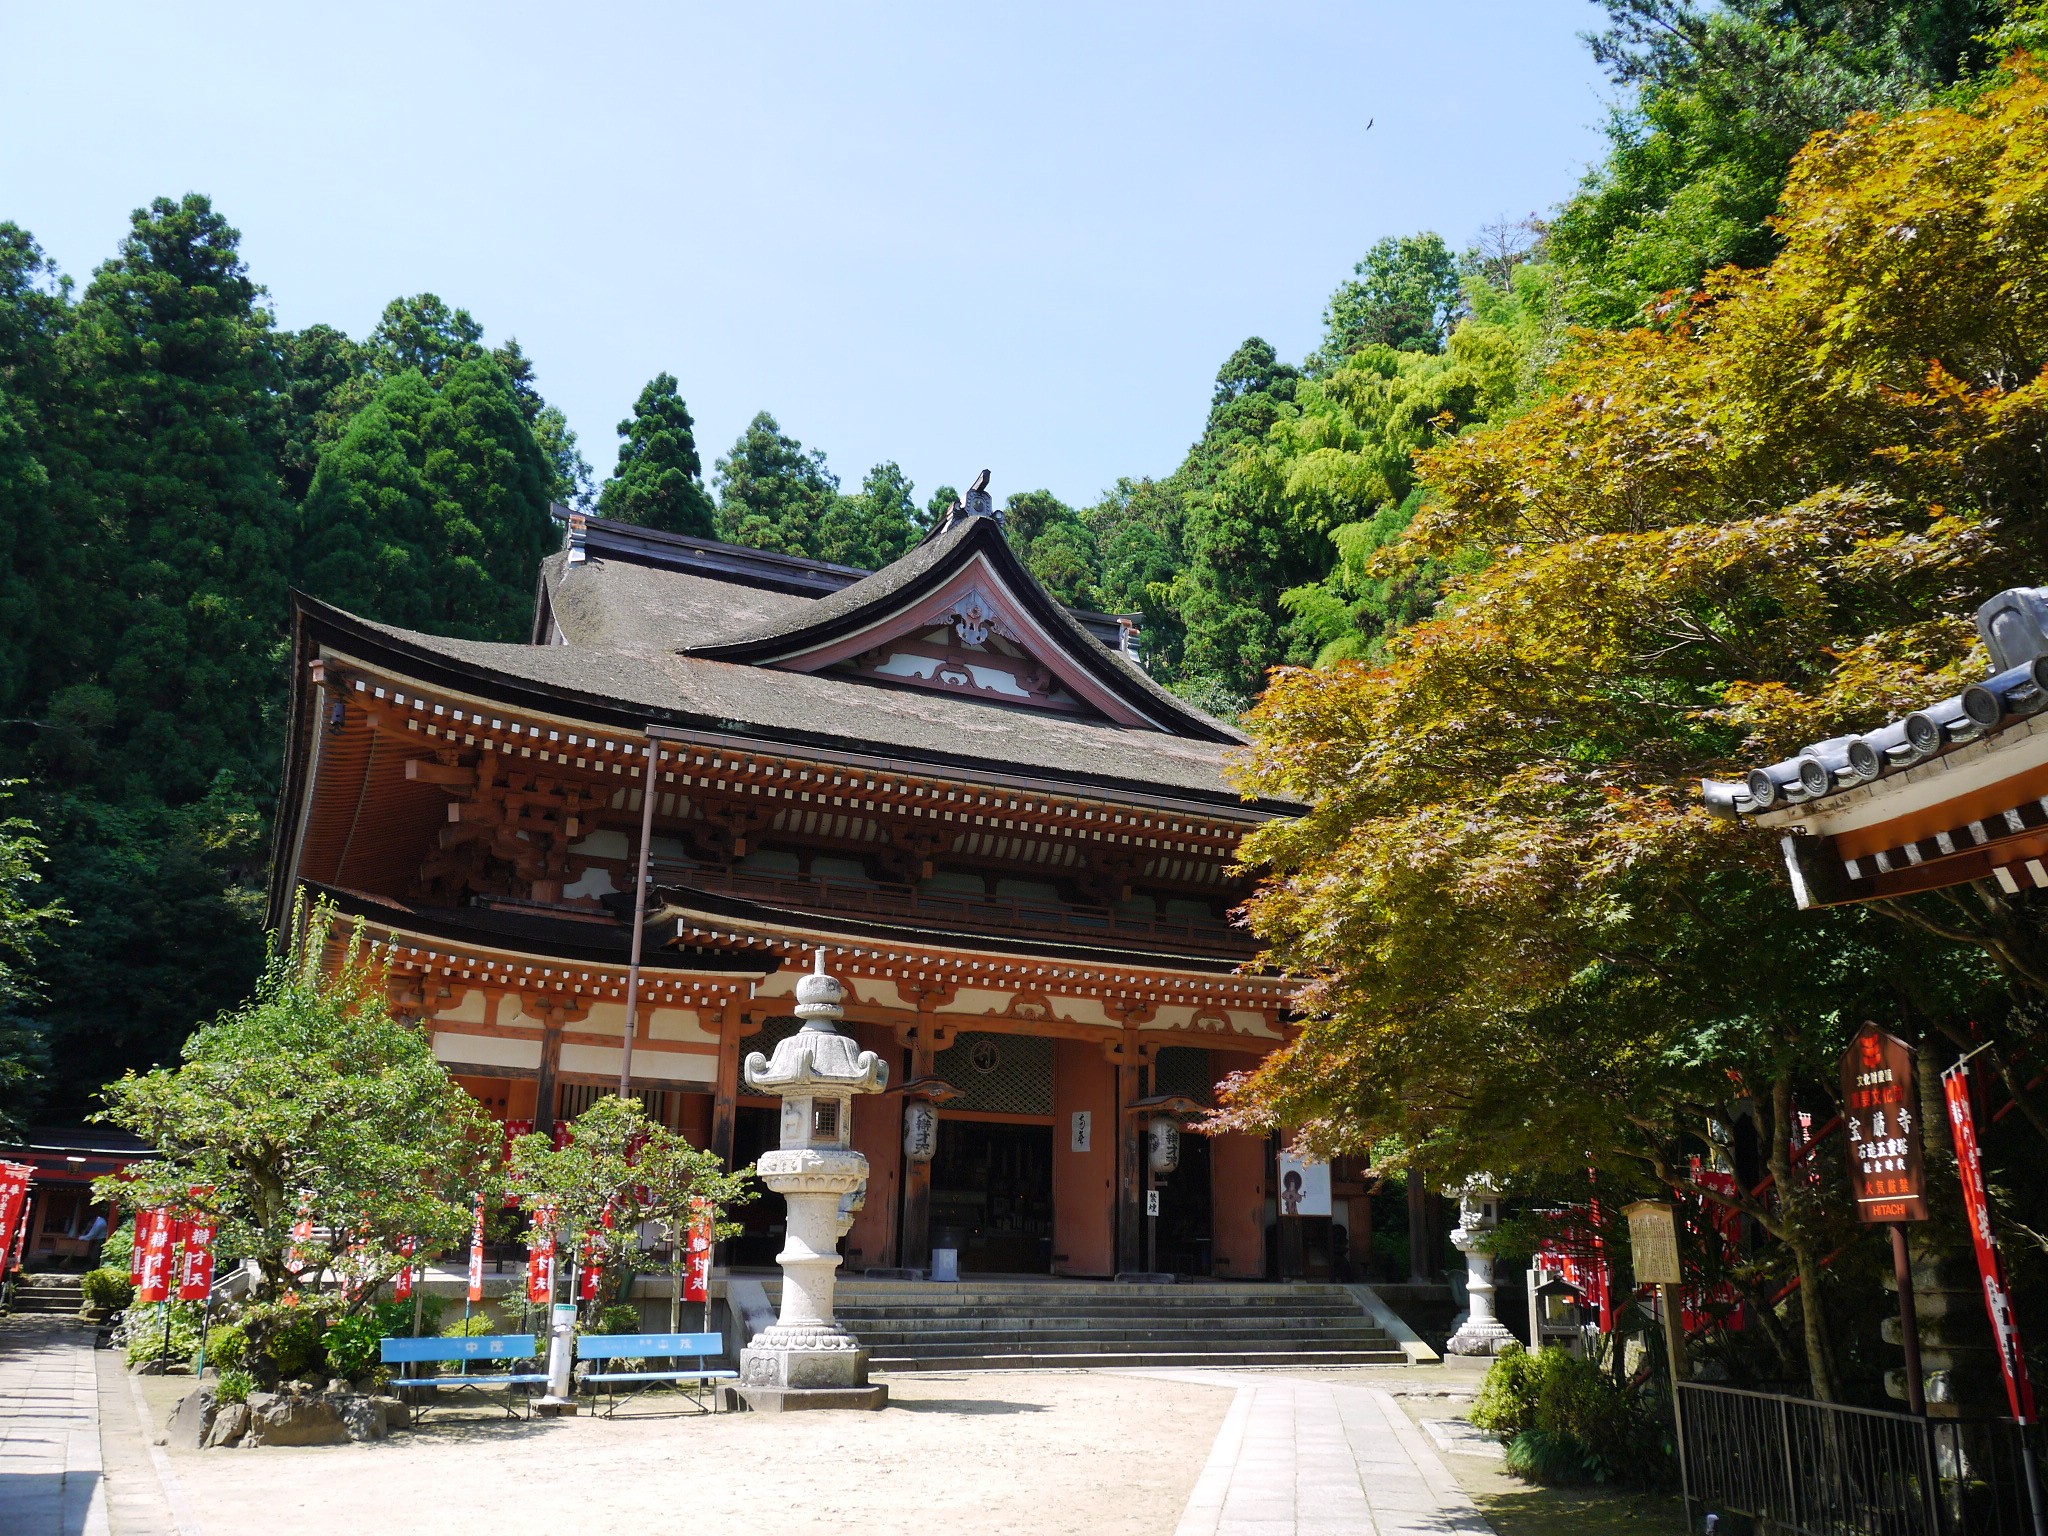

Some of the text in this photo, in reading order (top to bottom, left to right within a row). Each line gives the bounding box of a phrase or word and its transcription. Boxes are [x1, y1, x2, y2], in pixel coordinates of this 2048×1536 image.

[1848, 1107, 1912, 1142] 宝厳寺
[1858, 1137, 1909, 1159] 石造五重塔
[1865, 1178, 1909, 1195] 火気厳禁
[1872, 1204, 1906, 1216] HITACHI
